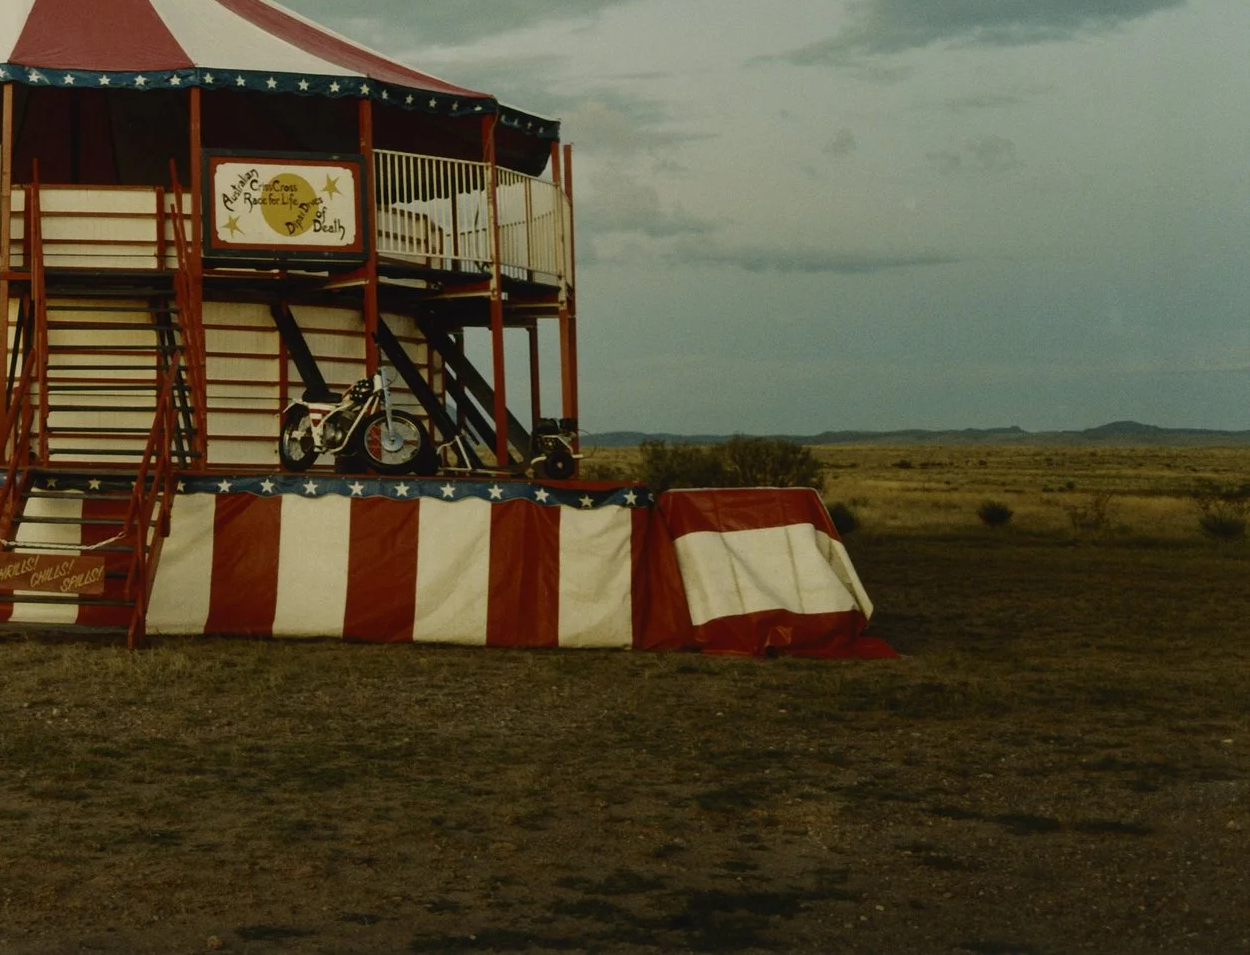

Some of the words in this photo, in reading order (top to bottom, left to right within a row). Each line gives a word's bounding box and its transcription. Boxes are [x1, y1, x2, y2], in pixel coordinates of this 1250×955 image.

[222, 169, 259, 212] Australian
[316, 206, 327, 223] of
[312, 218, 346, 240] Death
[30, 559, 75, 588] CHILLS!
[60, 565, 104, 592] SPILLS!
